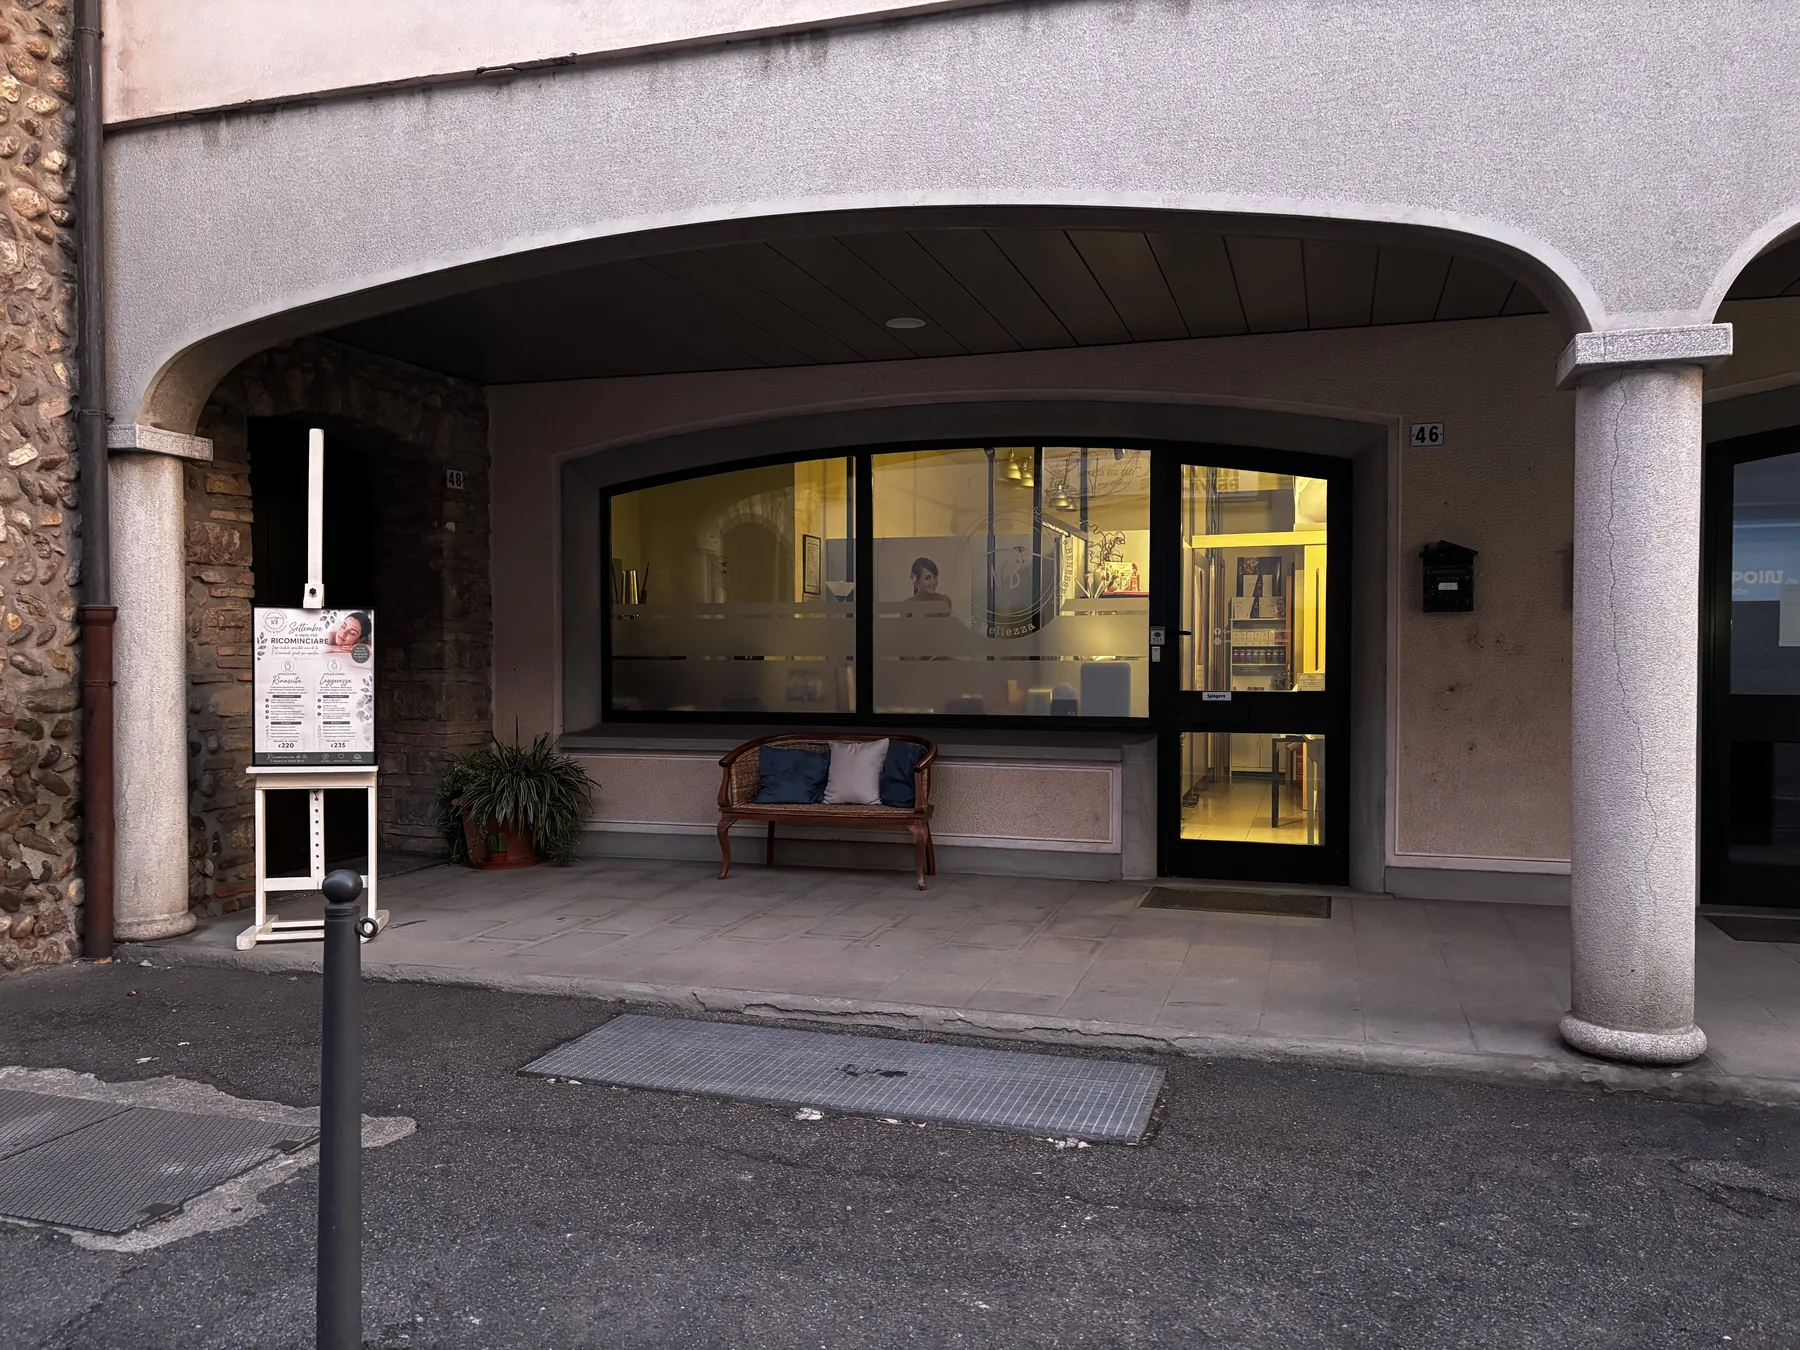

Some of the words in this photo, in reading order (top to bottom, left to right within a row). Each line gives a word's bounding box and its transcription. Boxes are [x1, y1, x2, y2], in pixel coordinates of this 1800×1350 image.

[1415, 425, 1439, 443] 46
[448, 471, 462, 487] 48
[288, 621, 323, 634] Settembre
[270, 637, 329, 645] RICOMINCIARE
[272, 674, 303, 685] Rinascita
[319, 675, 353, 687] Leggerezza
